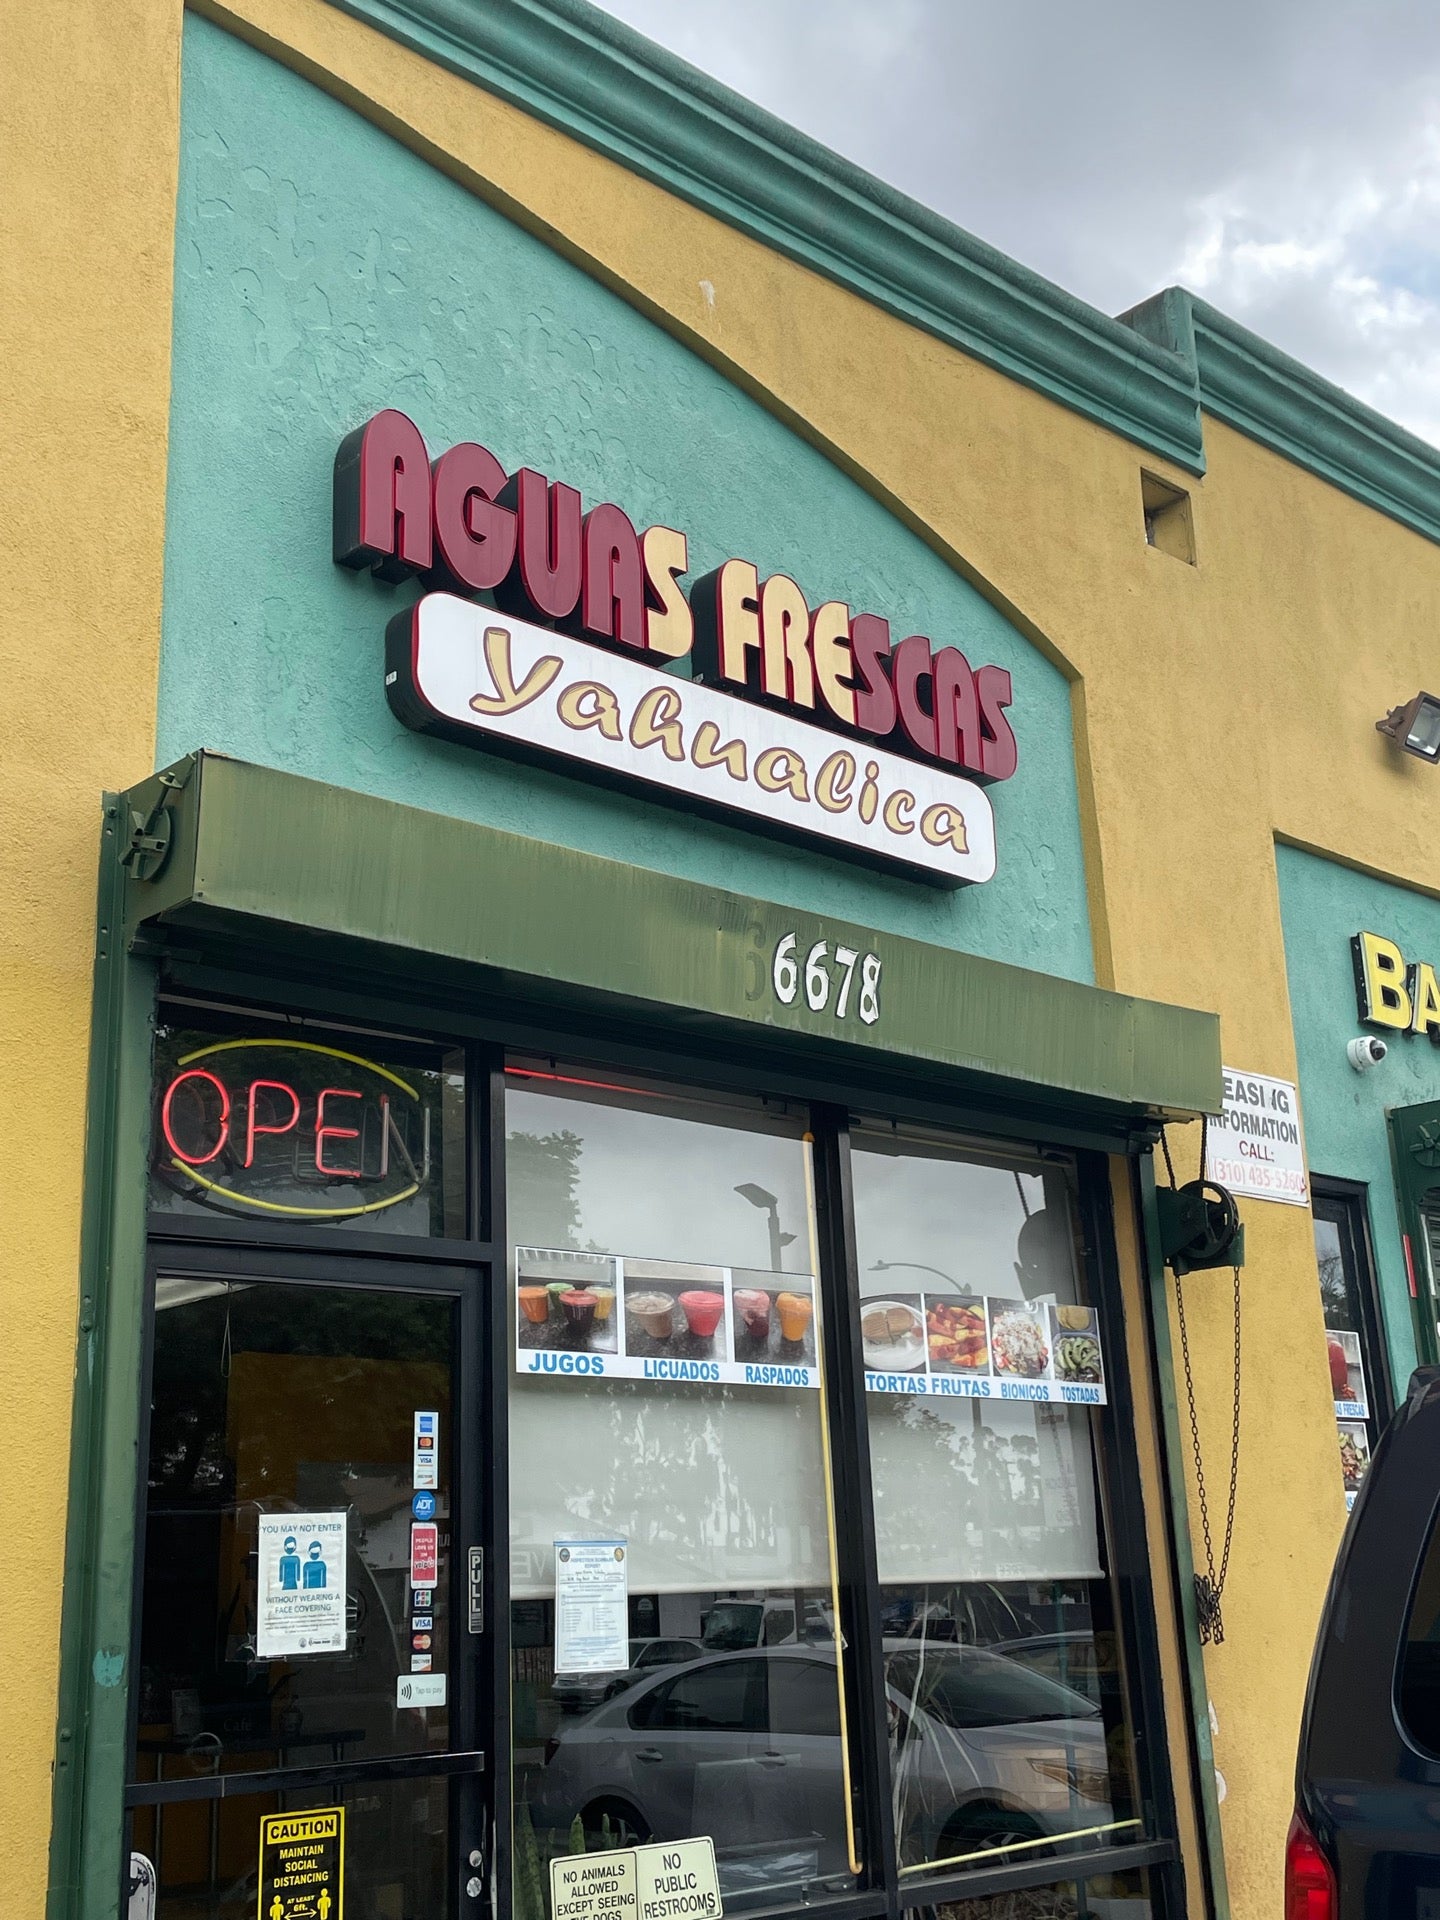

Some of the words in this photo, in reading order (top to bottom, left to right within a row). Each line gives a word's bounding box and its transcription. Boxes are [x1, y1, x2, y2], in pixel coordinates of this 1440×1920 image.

[358, 408, 695, 660] AGUAS
[716, 557, 1018, 781] FRESCAS
[773, 931, 882, 1026] 6678
[162, 1068, 431, 1184] OPEN
[528, 1353, 604, 1375] JUGOS
[643, 1360, 720, 1381] LICUADOS
[745, 1366, 809, 1386] RASPADOS
[865, 1374, 927, 1393] TORTAS
[931, 1378, 990, 1397] FRUTAS
[1001, 1383, 1049, 1401] BIONICOS
[1060, 1386, 1100, 1403] TOSTADAS
[416, 1500, 432, 1510] ADT
[262, 1525, 279, 1533] YOU
[280, 1525, 298, 1533] MAY
[299, 1524, 316, 1532] NOT
[317, 1523, 342, 1532] ENTER
[471, 1555, 481, 1613] PULL
[265, 1595, 298, 1604] WITHOUT
[299, 1593, 333, 1602] WEARING
[274, 1605, 293, 1614] FACE
[294, 1604, 332, 1613] COVERING
[414, 1619, 432, 1628] VISA
[415, 1687, 425, 1695] Tap
[270, 1819, 334, 1840] CAUTION
[279, 1844, 324, 1860] MAINTAIN
[662, 1852, 682, 1871] NO
[285, 1859, 318, 1873] SOCIAL
[563, 1871, 578, 1884] NO
[581, 1864, 625, 1882] ANIMALS
[273, 1870, 329, 1889] DISTANCING
[570, 1880, 619, 1898] ALLOWED
[654, 1872, 698, 1895] PUBLIC
[295, 1895, 315, 1903] LEAST
[557, 1899, 594, 1916] EXCEPT
[597, 1893, 635, 1910] SEEING
[643, 1892, 716, 1920] RESTROOMS
